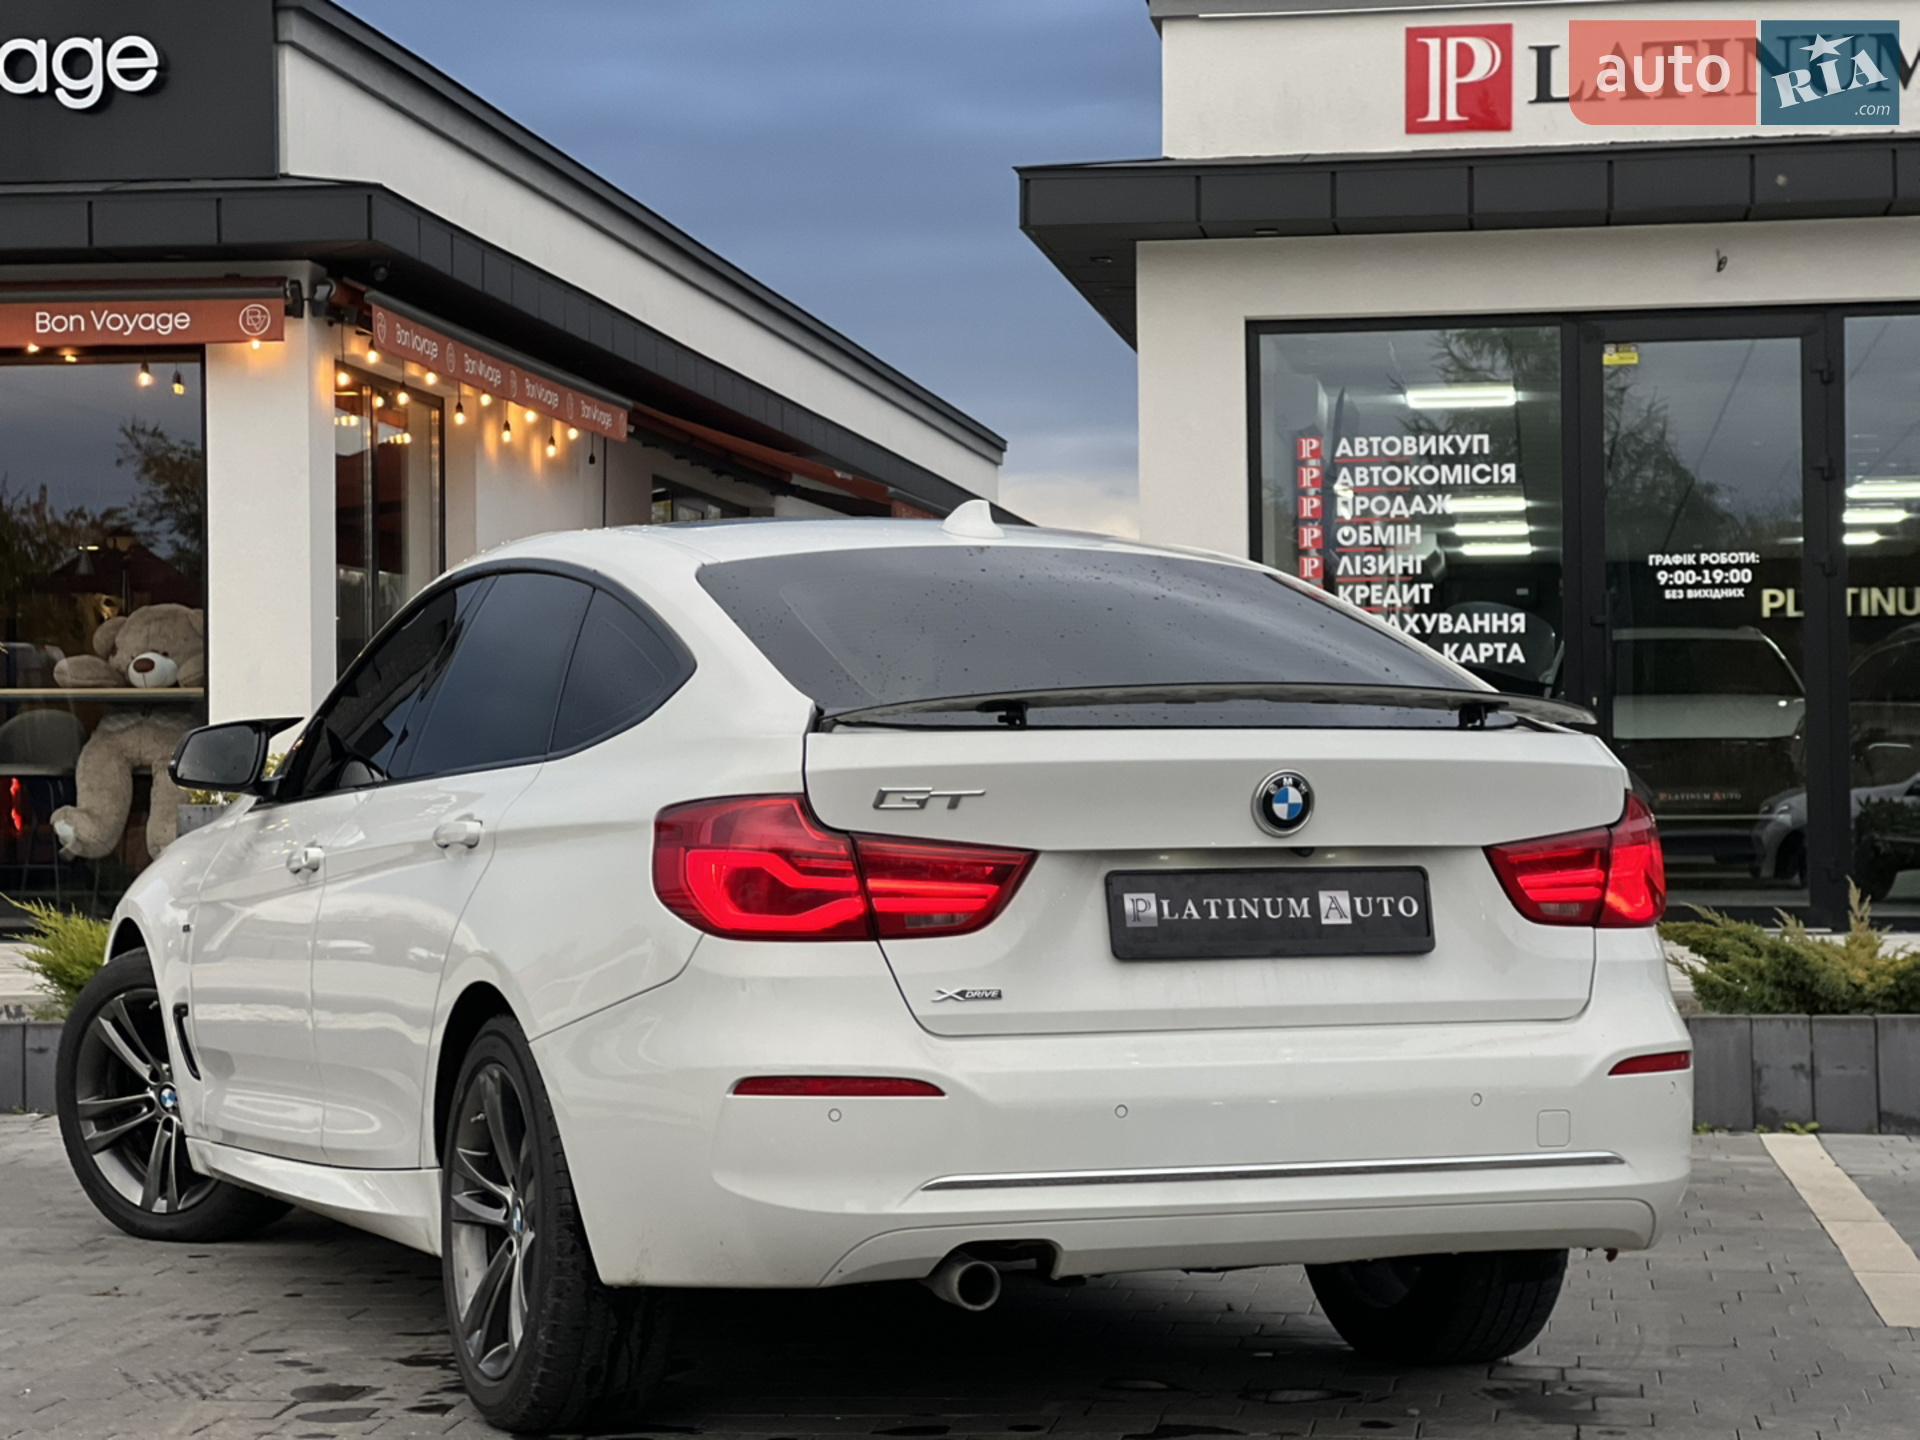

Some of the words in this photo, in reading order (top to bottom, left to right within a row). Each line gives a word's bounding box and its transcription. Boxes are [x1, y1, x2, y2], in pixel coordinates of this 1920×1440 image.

[0, 35, 159, 109] age
[35, 311, 85, 333] Bon
[90, 309, 191, 336] Voyage
[1335, 434, 1489, 457] АВТОВИКУП
[1336, 464, 1516, 487] АВТОКОМІСІЯ
[1337, 494, 1452, 518] ПРОДАЖ
[1337, 524, 1422, 546] ОБМІН
[1337, 553, 1427, 575] ЛІЗИНГ
[1648, 554, 1697, 566] ГРАФІК
[1699, 551, 1760, 564] РОБОТИ:
[1656, 568, 1753, 585] 9:00-19:00
[1338, 583, 1434, 607] КРЕДИТ
[1664, 588, 1685, 599] БЕЗ
[1686, 587, 1745, 599] ВИХІДНИХ
[1443, 642, 1526, 663] КАРТА
[872, 786, 986, 810] GT
[1126, 896, 1311, 924] PLATINUM
[1320, 894, 1420, 921] AUTO
